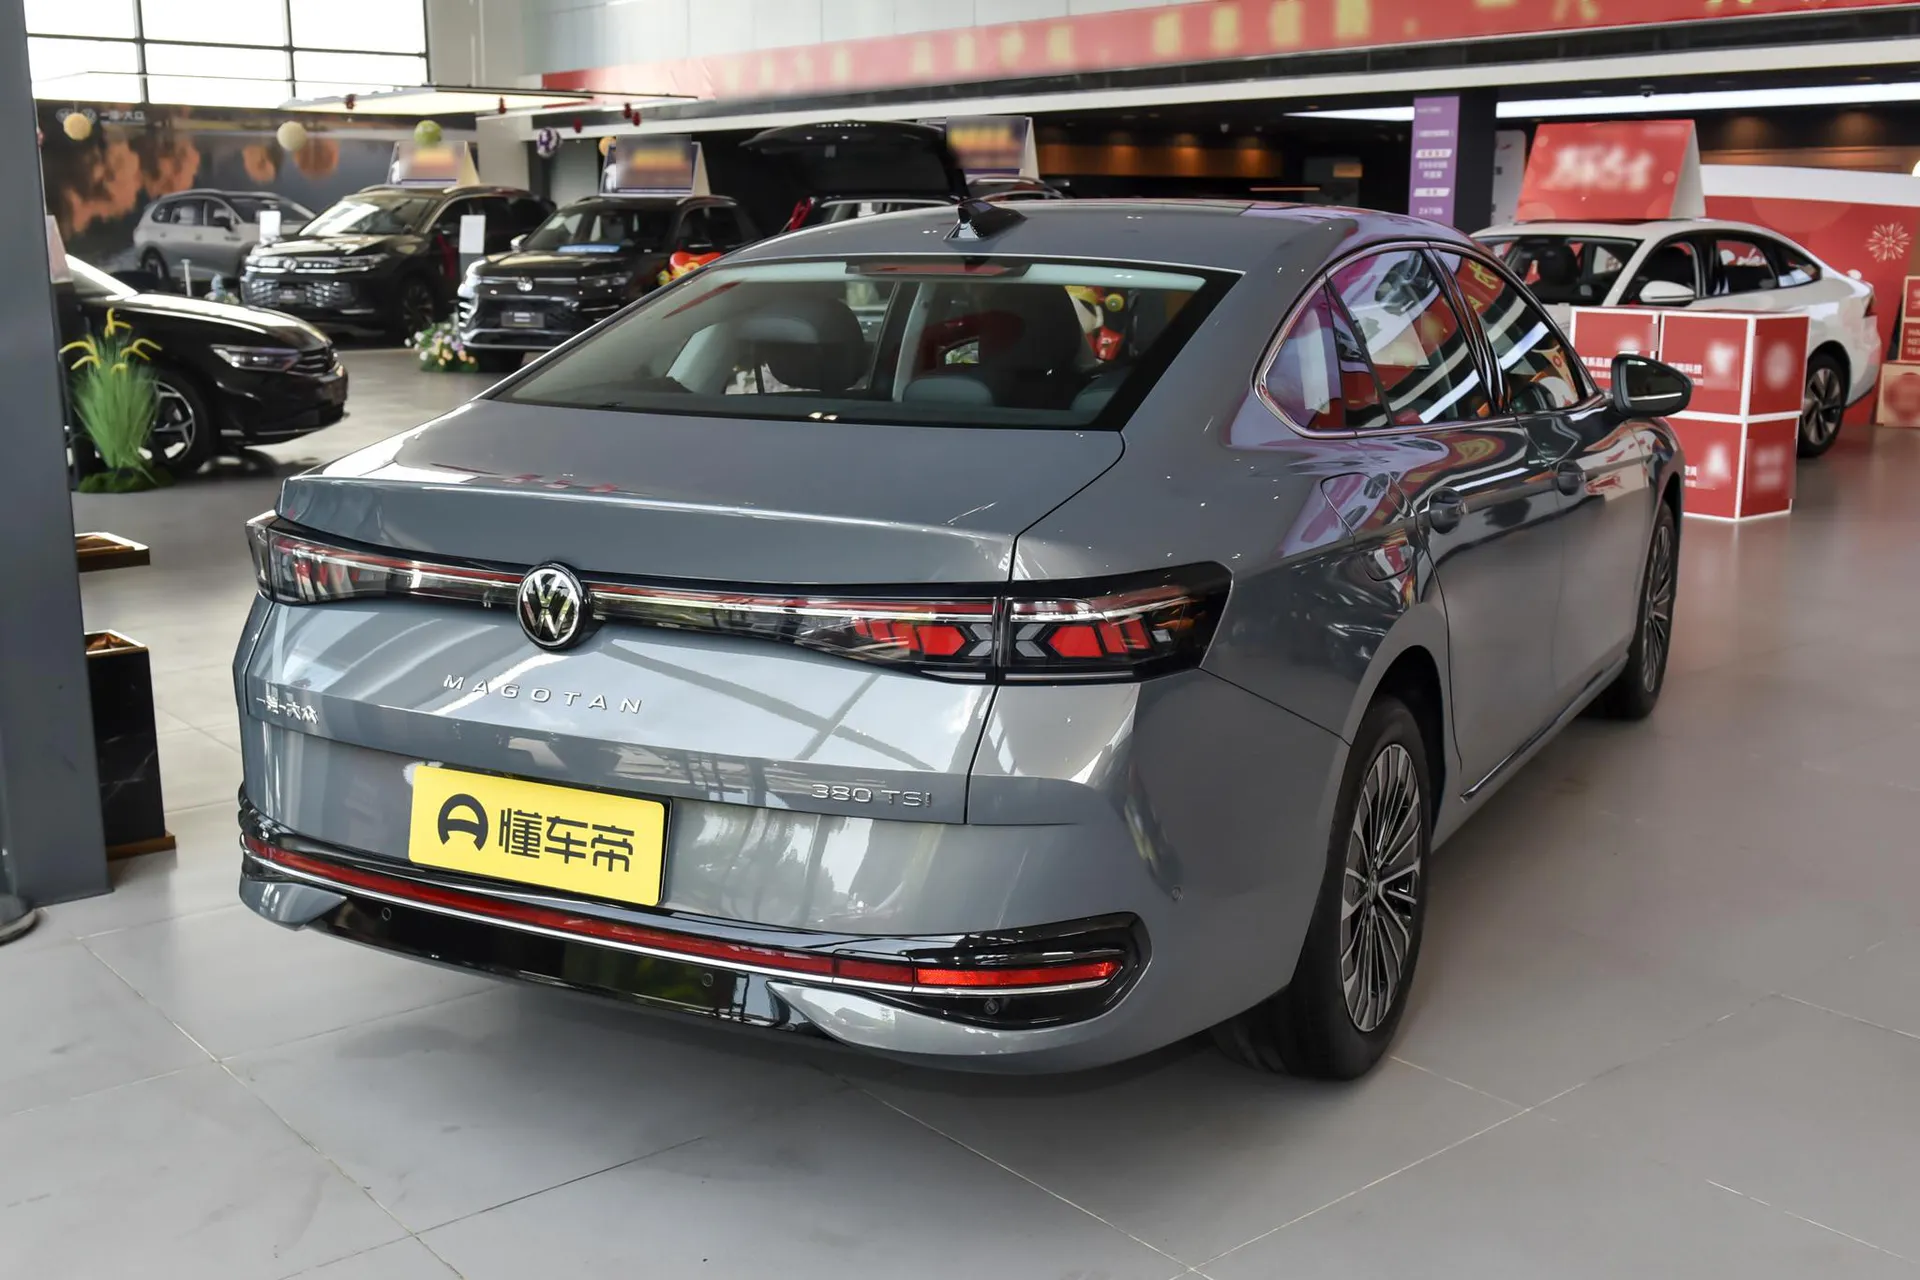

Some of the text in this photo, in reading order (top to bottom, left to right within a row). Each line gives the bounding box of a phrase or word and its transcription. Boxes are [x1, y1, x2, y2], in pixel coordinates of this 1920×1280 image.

[443, 674, 642, 714] MAGOTAN
[811, 783, 932, 807] 380 TSI
[499, 807, 635, 873] 懂车帝
